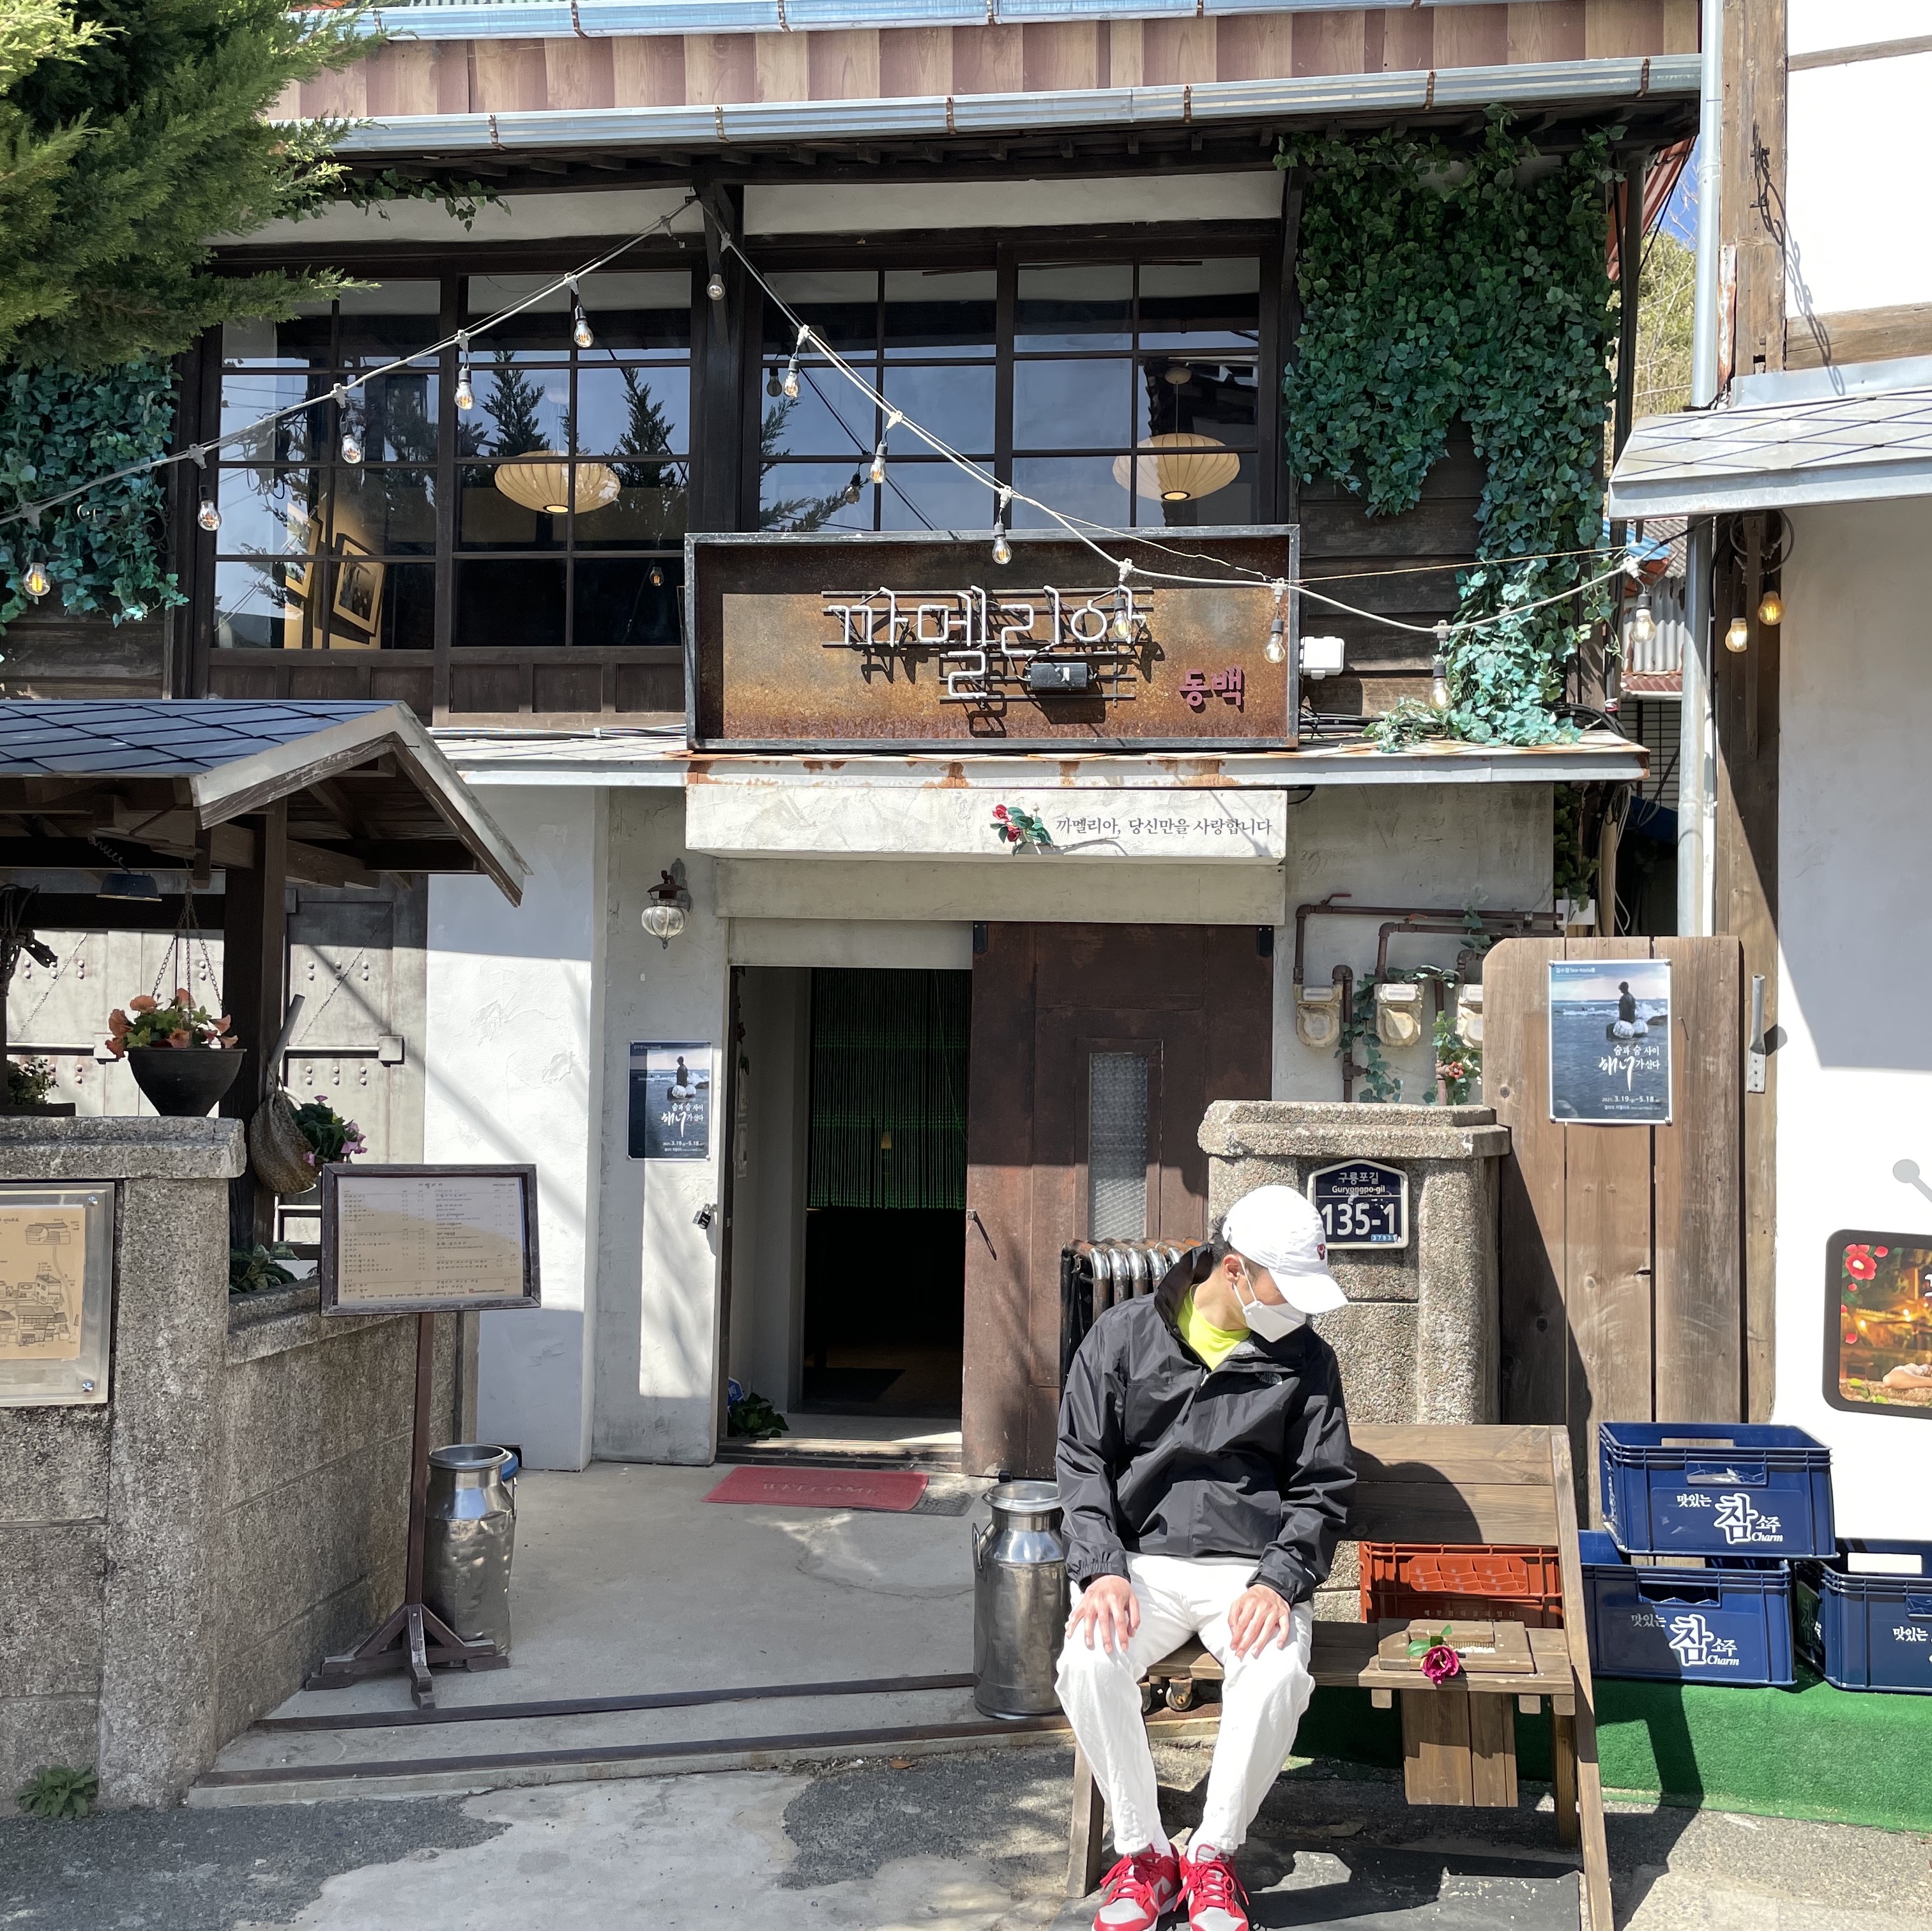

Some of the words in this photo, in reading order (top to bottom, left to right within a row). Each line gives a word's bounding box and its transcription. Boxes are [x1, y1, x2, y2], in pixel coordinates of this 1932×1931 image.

[828, 584, 1147, 697] 까멜리아
[1179, 664, 1242, 706] 동백
[1056, 817, 1122, 835] 까멜리아,
[1128, 817, 1190, 835] 당신만을
[1192, 817, 1273, 836] 사랑합니다
[1632, 1045, 1642, 1056] 숨
[1643, 1045, 1659, 1056] 사이
[1338, 1171, 1379, 1185] 구룡포길
[1332, 1185, 1385, 1195] Guryongpo-gil
[1321, 1202, 1395, 1236] 135-1
[1677, 1493, 1712, 1508] 맛있는
[1713, 1492, 1759, 1545] 참
[1751, 1531, 1784, 1542] Charm
[1631, 1613, 1667, 1628] 맛있는
[1668, 1614, 1715, 1667] 참
[1892, 1626, 1929, 1642] 맛있는
[1707, 1655, 1740, 1666] Charm
